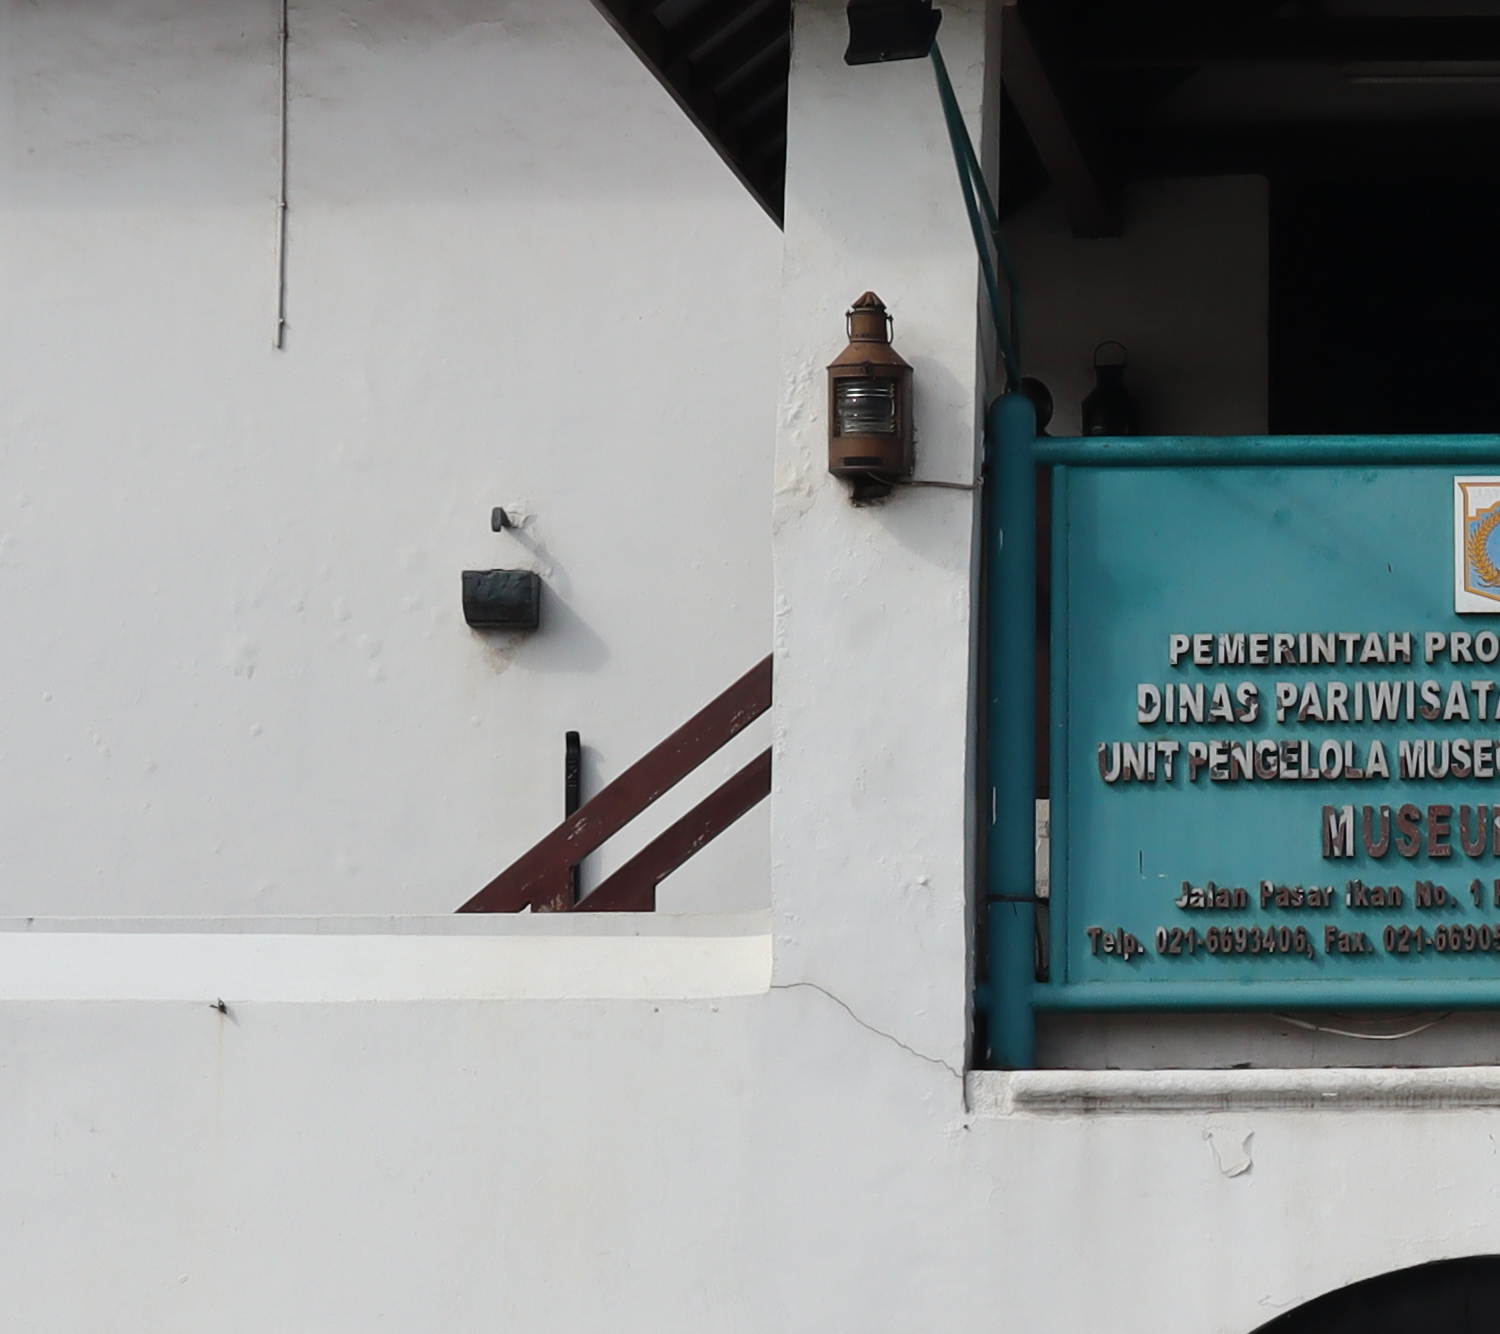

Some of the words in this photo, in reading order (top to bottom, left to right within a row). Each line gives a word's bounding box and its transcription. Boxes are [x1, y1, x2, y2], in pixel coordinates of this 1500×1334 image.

[1170, 632, 1411, 665] PEMERINTAH
[1137, 681, 1259, 724] DINAS
[1098, 740, 1180, 782] UNIT
[1188, 739, 1390, 781] PENGELOLA
[1175, 880, 1246, 909] Jalan
[1260, 880, 1334, 908] Pasar
[1345, 879, 1401, 907] Ikan
[1415, 880, 1456, 907] No.
[1470, 879, 1480, 907] 1
[1088, 926, 1144, 960] Telp.
[1155, 925, 1313, 959] 021-6693406,
[1325, 925, 1372, 953] Fax.
